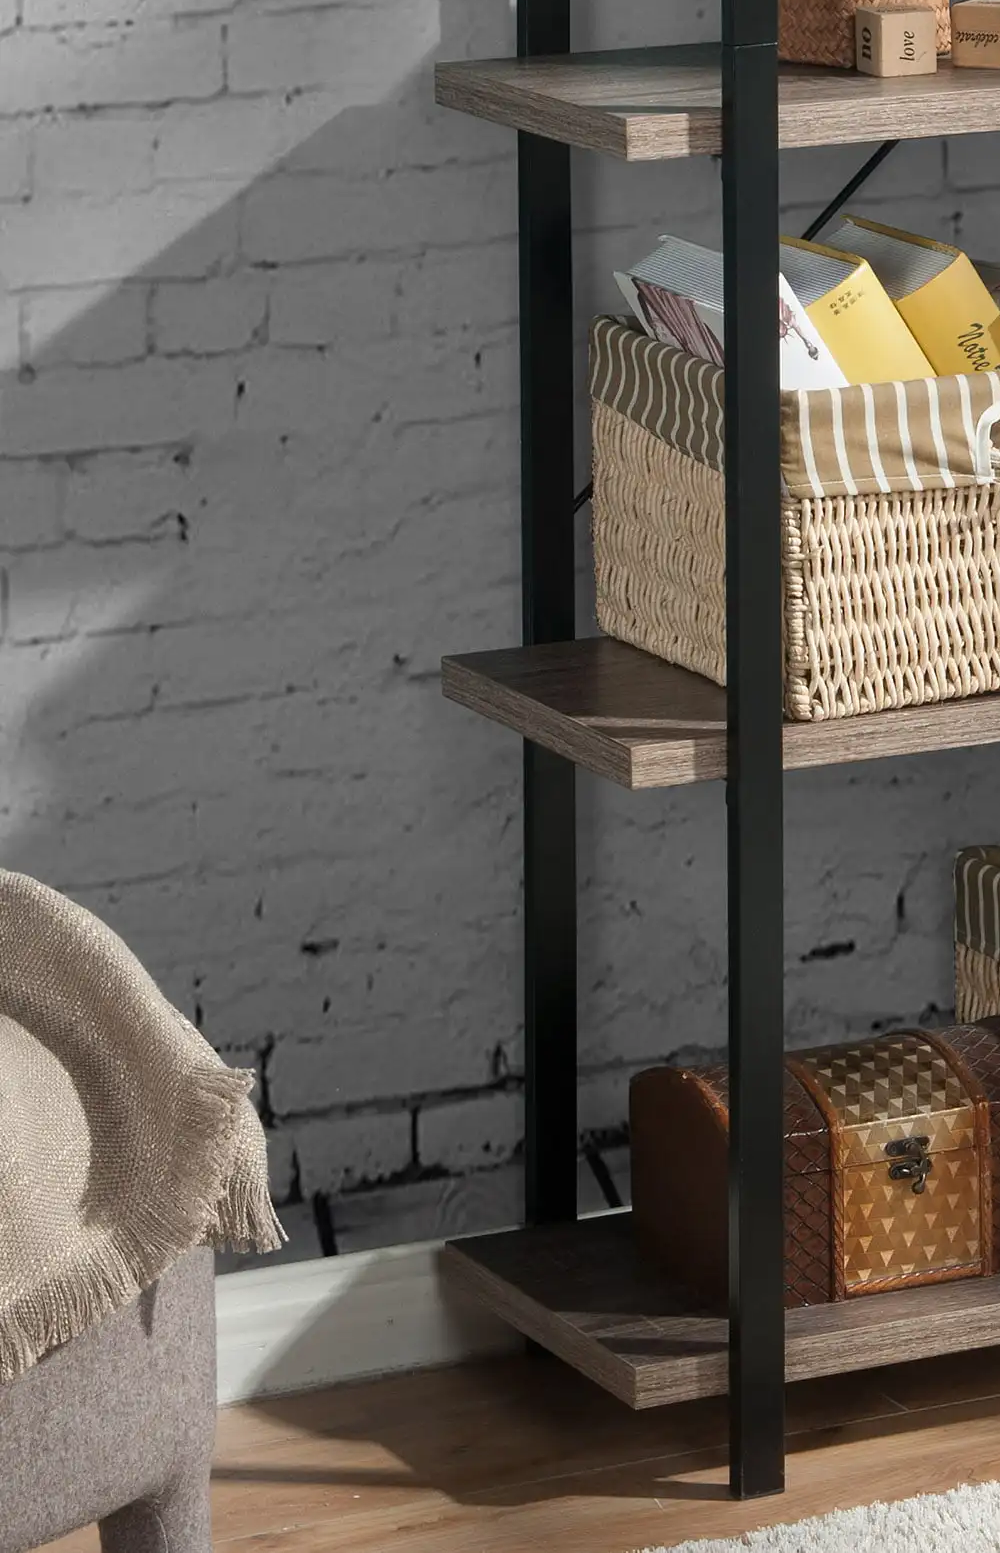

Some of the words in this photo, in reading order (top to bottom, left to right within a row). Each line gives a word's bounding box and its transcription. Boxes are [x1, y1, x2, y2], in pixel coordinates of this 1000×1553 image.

[861, 27, 872, 61] no
[899, 30, 916, 62] love
[954, 30, 1000, 48] celebrate
[957, 322, 991, 373] Notre
